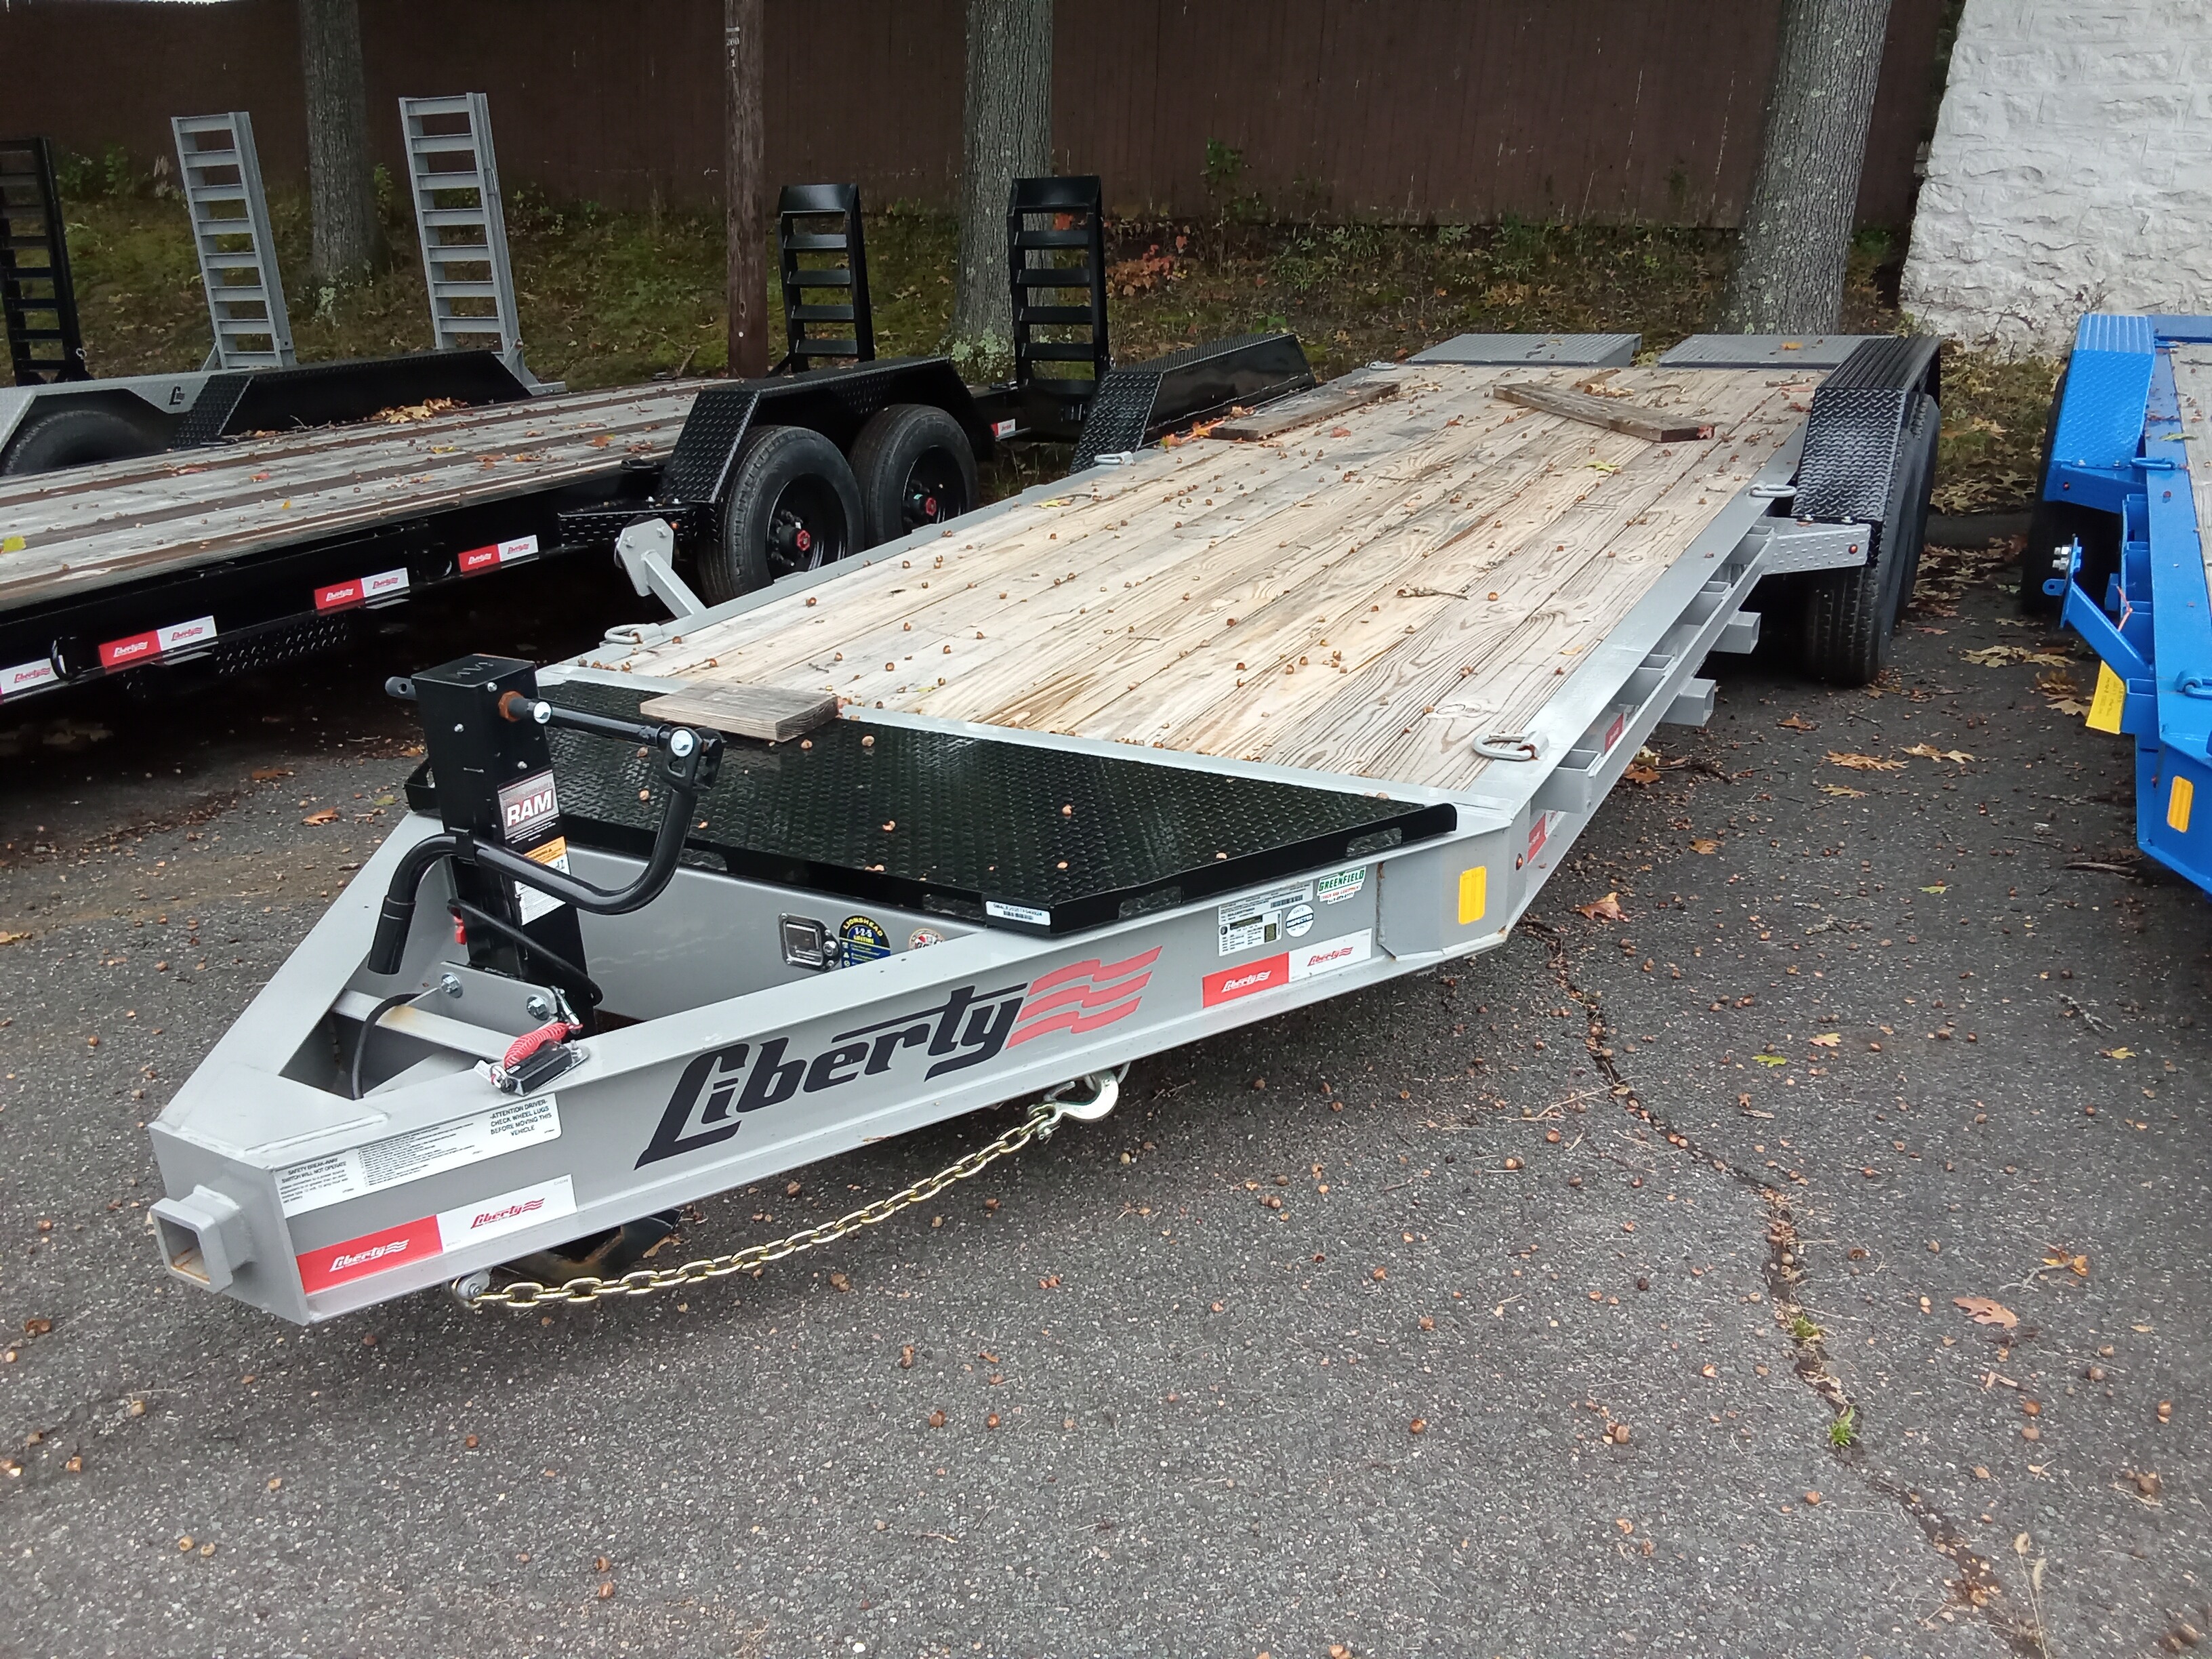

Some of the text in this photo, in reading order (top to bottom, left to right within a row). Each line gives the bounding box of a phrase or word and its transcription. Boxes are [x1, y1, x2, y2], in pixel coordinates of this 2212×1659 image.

[506, 790, 552, 827] RAM
[1318, 869, 1365, 892] GREENFIELD
[843, 917, 883, 937] LIONSHEAD
[1307, 950, 1339, 966] Liberty
[1221, 974, 1256, 994] Liberty
[634, 982, 1028, 1171] Liberty
[491, 1105, 550, 1127] CHECK WHEEL LUGS
[491, 1112, 552, 1134] BEFORE MOVING THIS
[510, 1125, 535, 1136] VEHICLE
[314, 1166, 325, 1174] NOT
[470, 1205, 523, 1230] Liberty
[329, 1246, 386, 1273] Liberty
